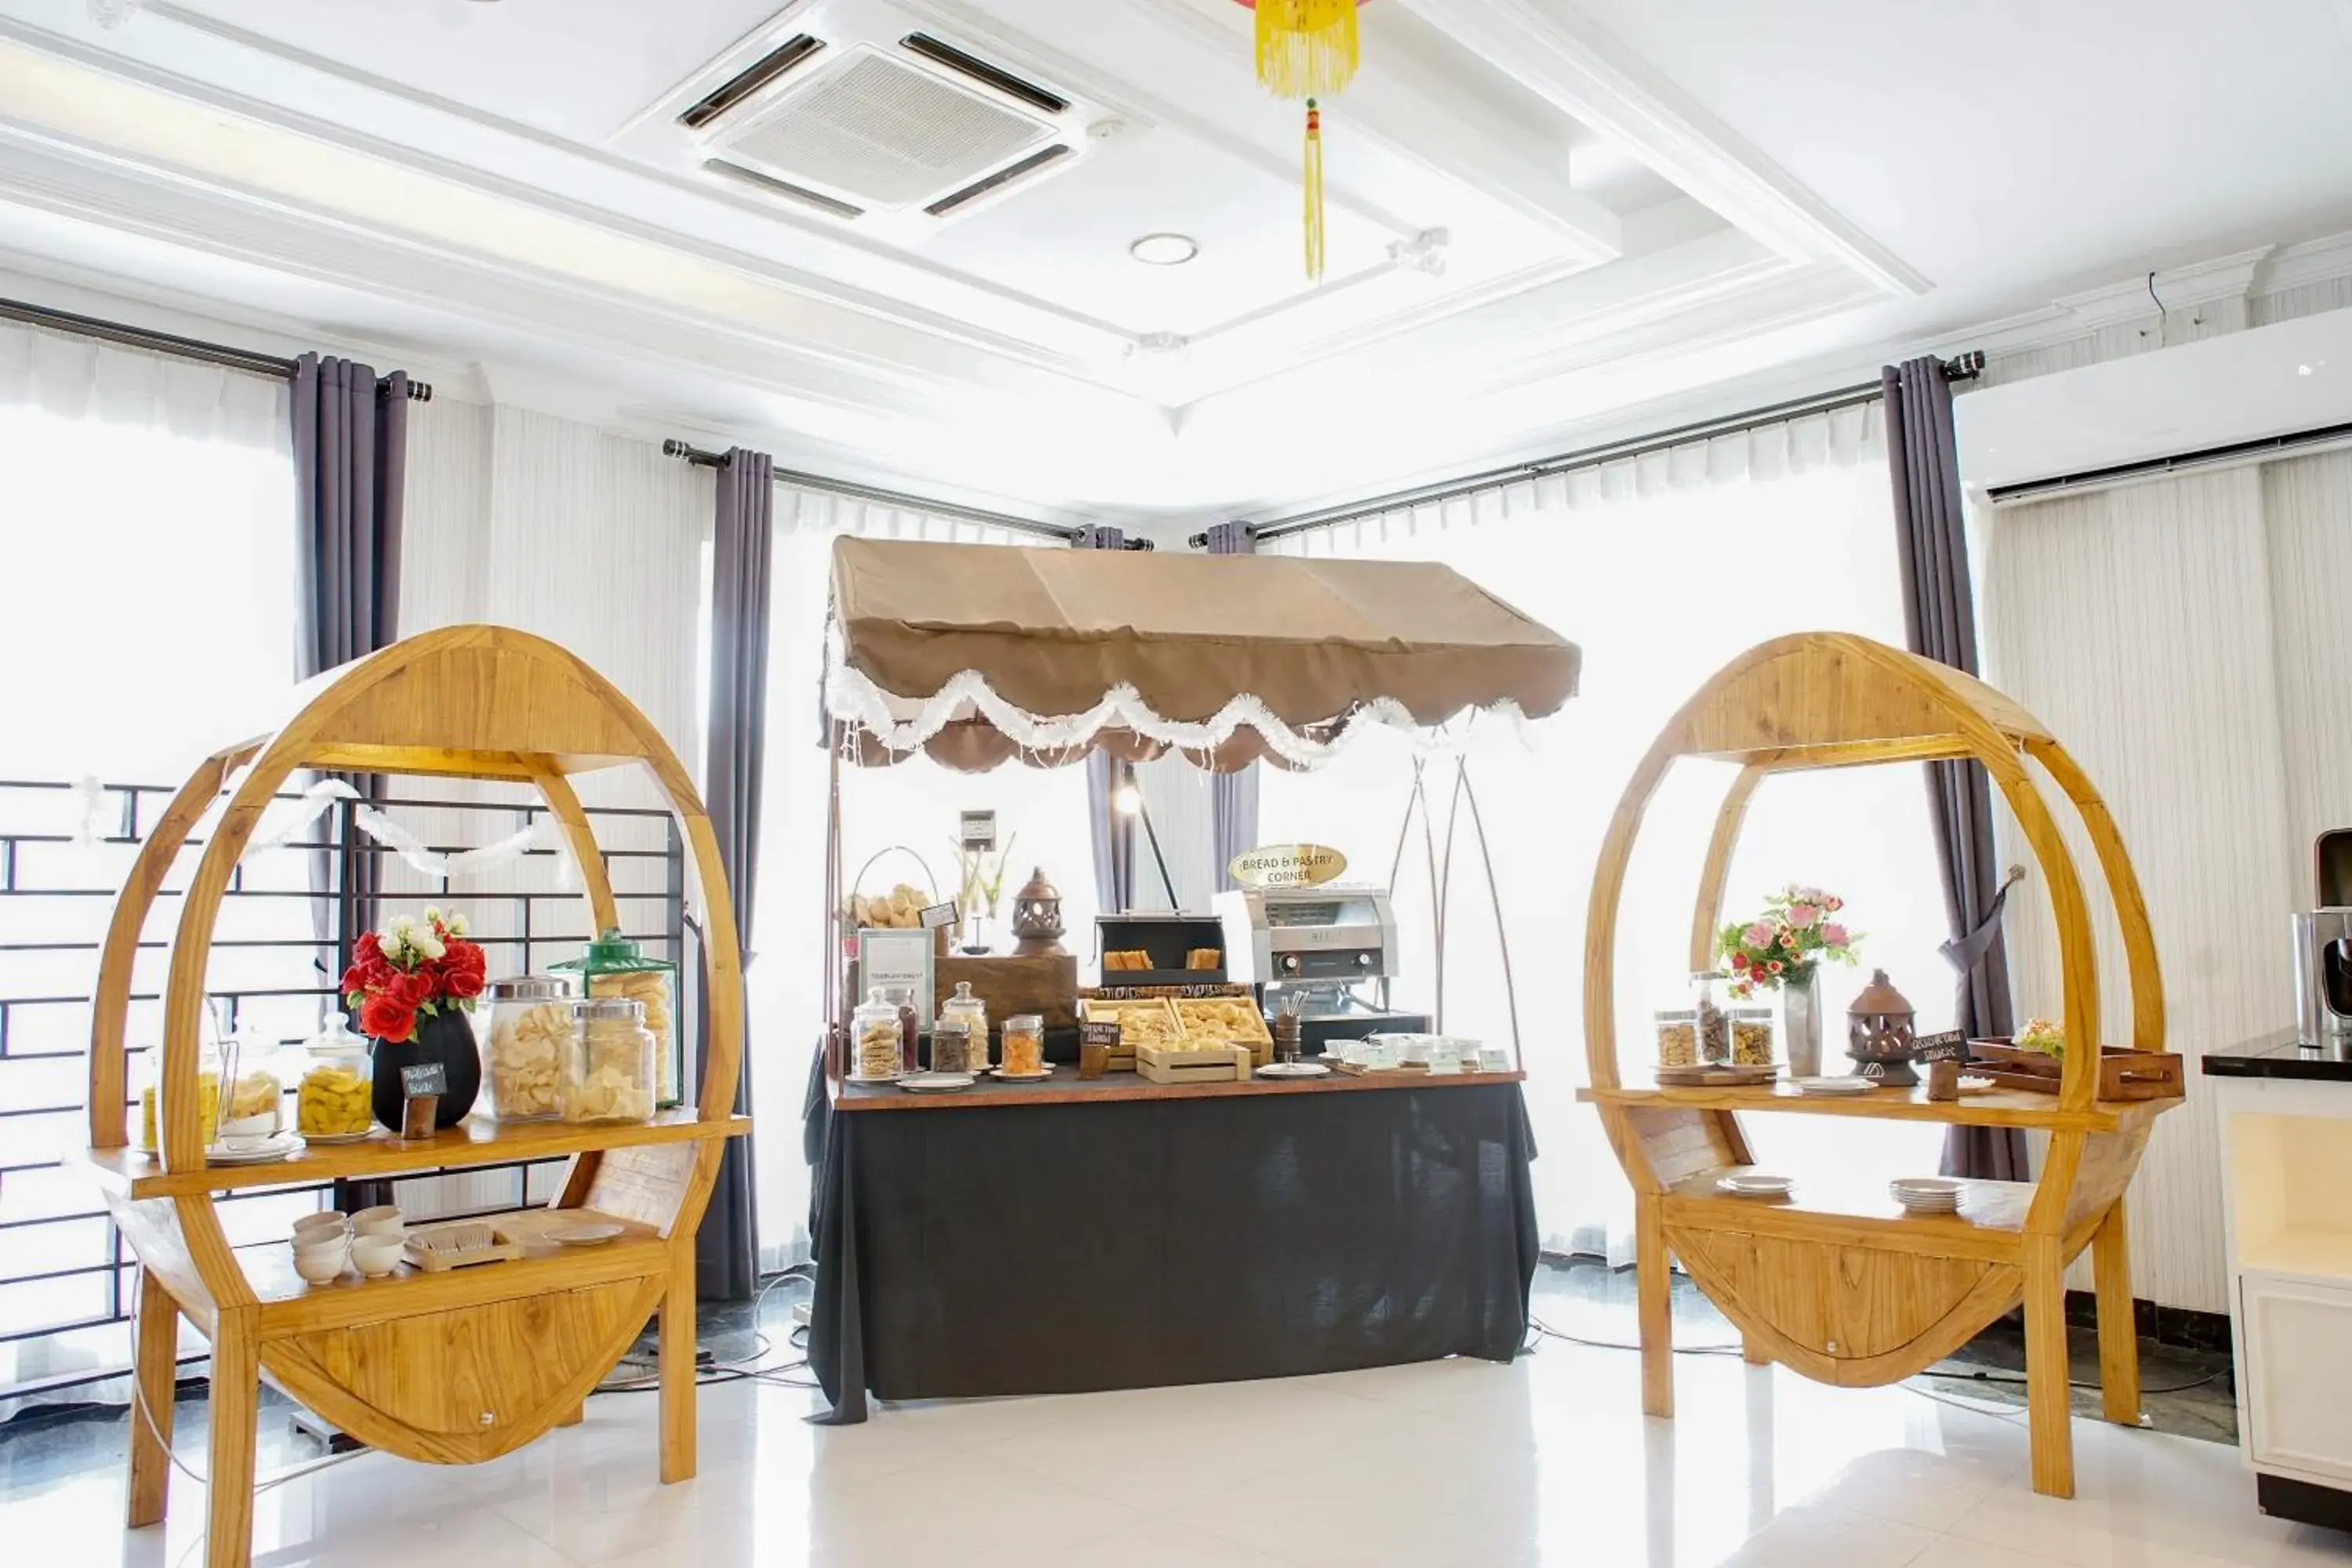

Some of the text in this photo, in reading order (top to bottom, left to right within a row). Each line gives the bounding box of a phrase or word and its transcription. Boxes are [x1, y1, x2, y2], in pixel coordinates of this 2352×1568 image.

[1242, 855, 1333, 870] BREAD & PASTRY
[1267, 870, 1312, 883] CORNER
